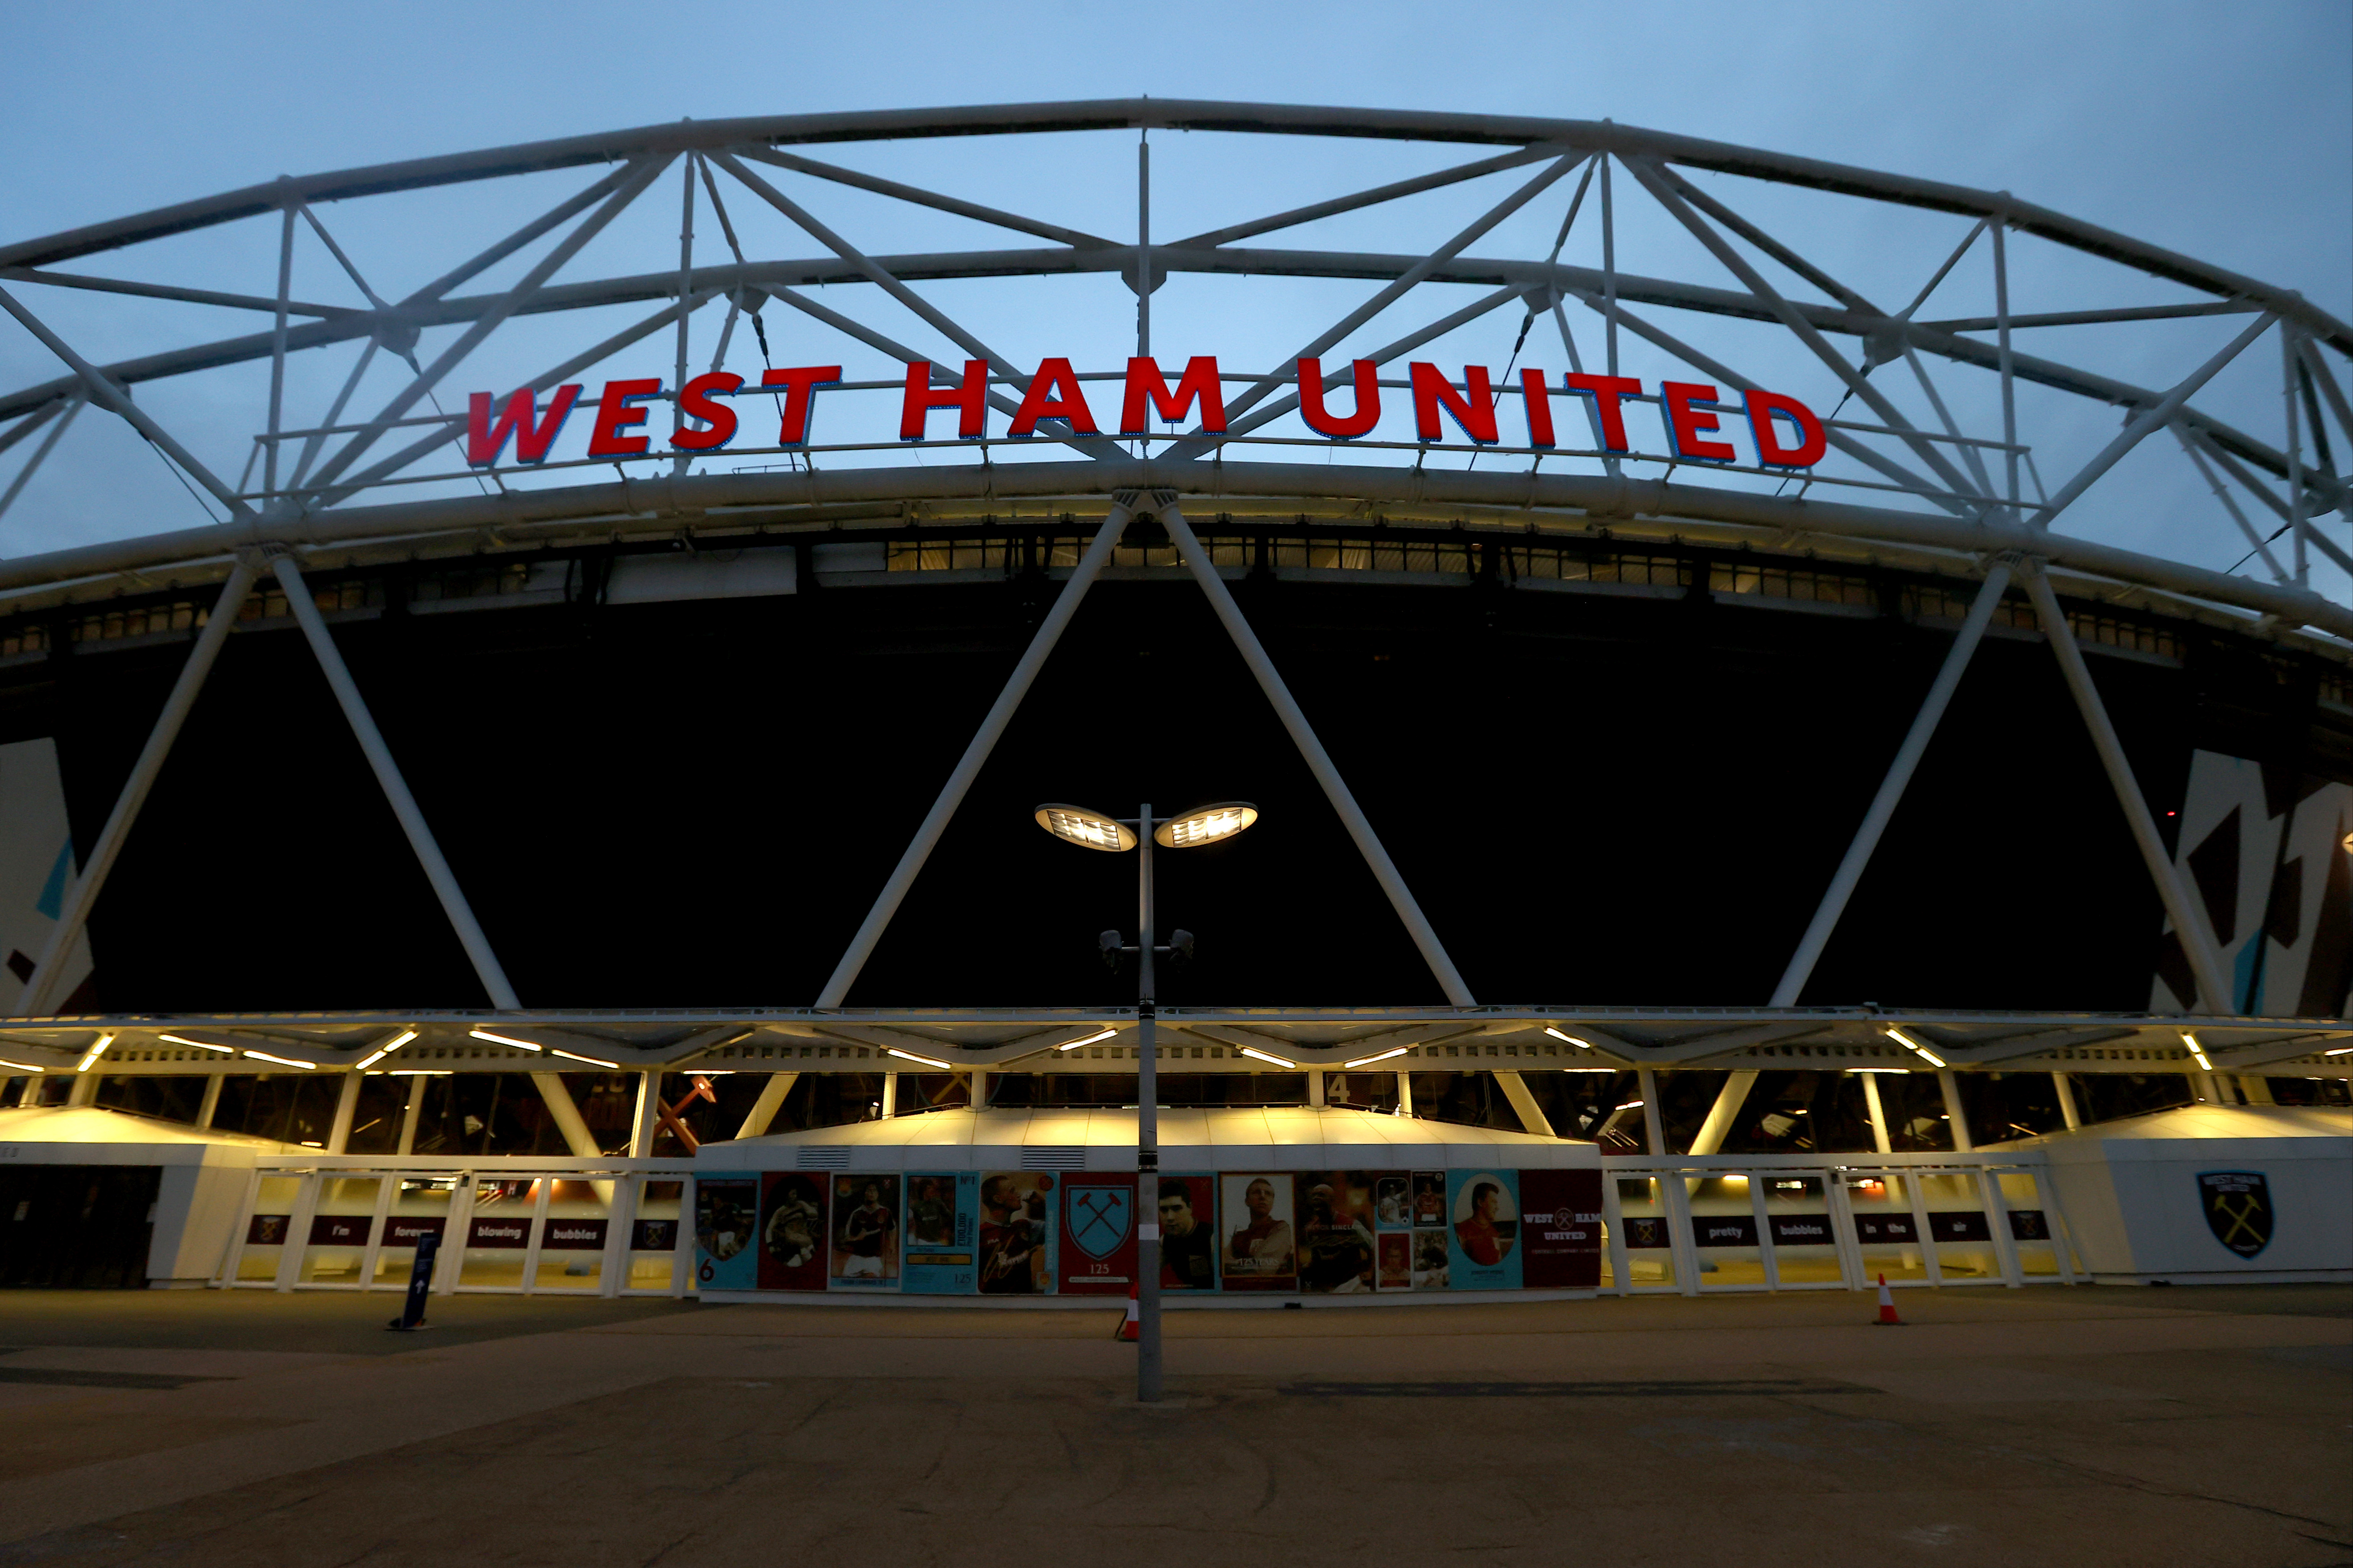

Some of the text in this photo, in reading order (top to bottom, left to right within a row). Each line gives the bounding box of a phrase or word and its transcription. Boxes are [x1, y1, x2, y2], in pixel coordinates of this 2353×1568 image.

[468, 356, 1827, 470] WEST HAM UNITED
[1328, 1075, 1350, 1103] 4
[1523, 1213, 1602, 1223] WEST HAM
[332, 1225, 350, 1236] I'm
[477, 1227, 522, 1240] blowing
[553, 1228, 597, 1240] bubbles
[1709, 1227, 1743, 1239] pretty
[1779, 1225, 1824, 1236] bubbles
[1887, 1222, 1907, 1234] the
[1543, 1231, 1587, 1241] UNITED
[1238, 1258, 1254, 1266] 125
[699, 1259, 714, 1282] 6
[1090, 1263, 1110, 1275] 125
[954, 1274, 972, 1283] 125
